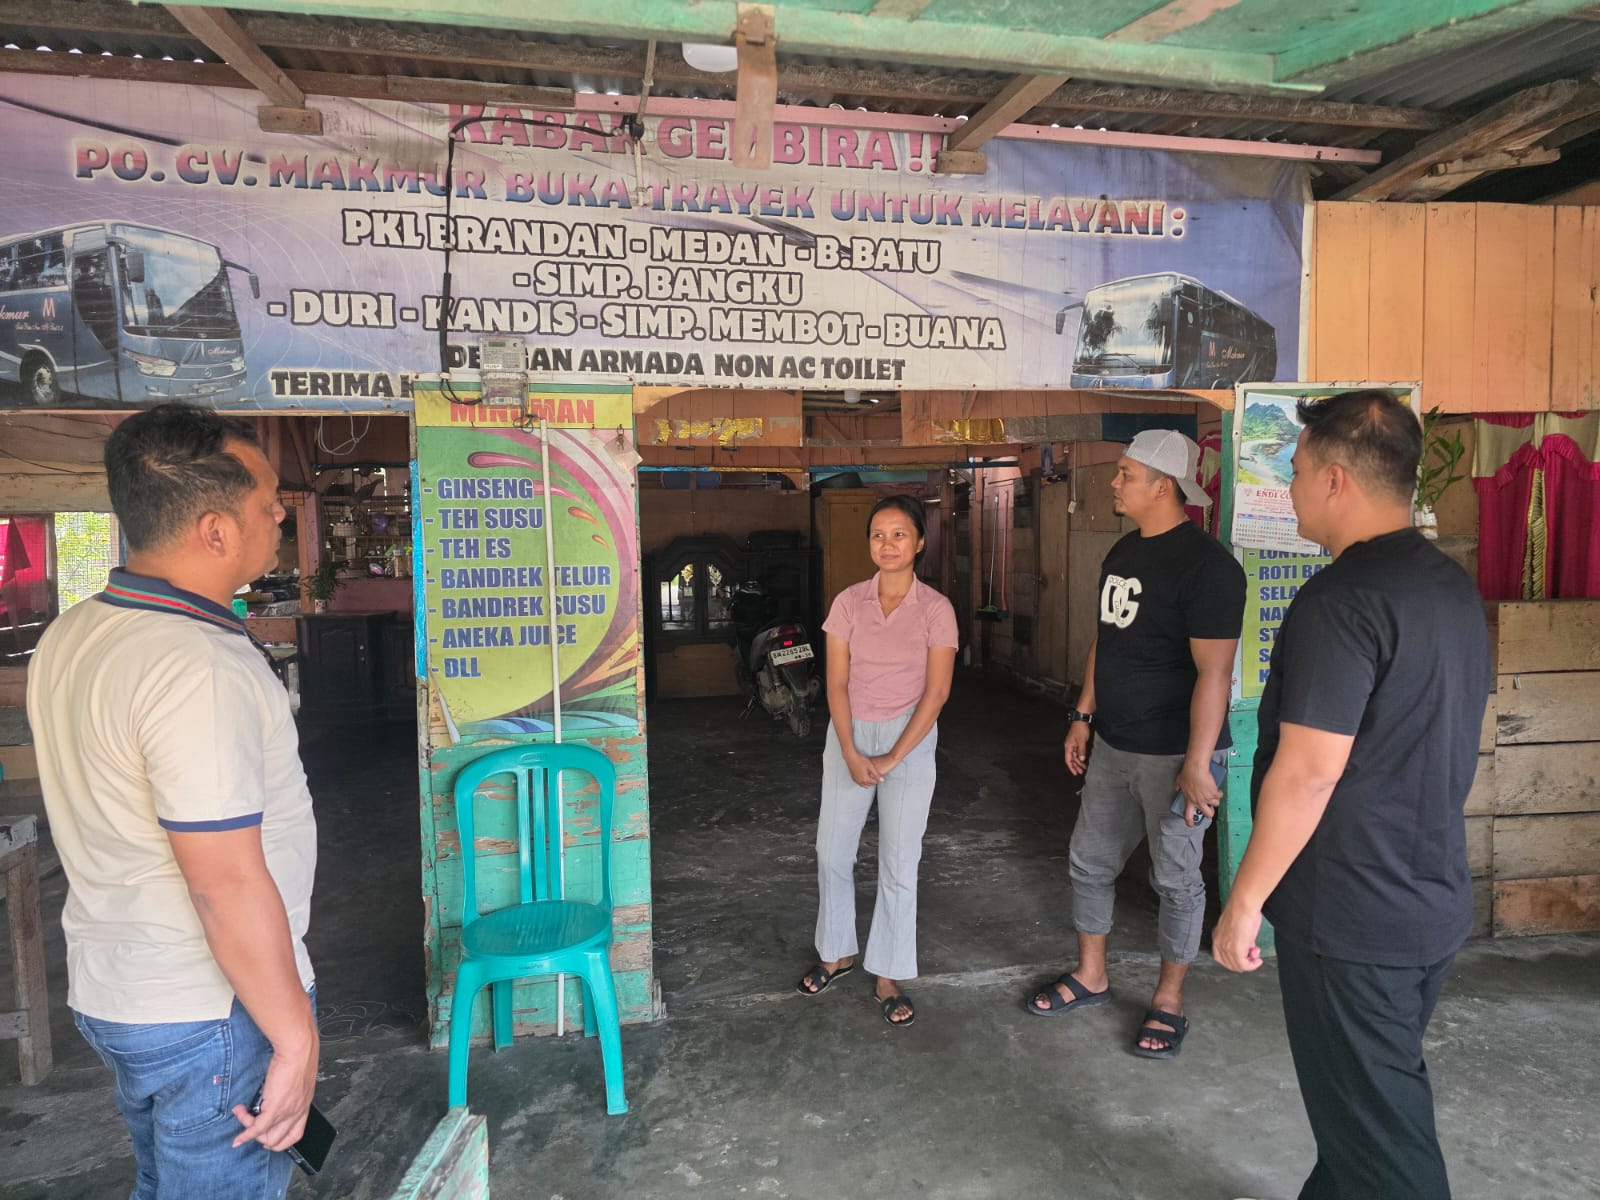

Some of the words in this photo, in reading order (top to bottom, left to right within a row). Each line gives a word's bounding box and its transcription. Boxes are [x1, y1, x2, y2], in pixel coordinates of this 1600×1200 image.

[657, 115, 898, 171] GEBIRA
[75, 143, 165, 182] PO.
[175, 146, 258, 187] CV.
[269, 153, 488, 200] MAKMUR
[505, 171, 632, 210] BUKA
[646, 182, 815, 220] TRAYEK
[831, 190, 964, 227] UNTUK
[342, 208, 425, 250] PKL
[650, 228, 787, 267] MEDAN
[814, 234, 941, 274] B.BATU
[646, 266, 802, 306] BANGKU
[290, 289, 396, 329] DURI
[423, 296, 577, 336] KANDIS
[708, 307, 864, 345] MEMBOT
[883, 312, 1007, 350] BUANA
[447, 345, 572, 371] DEAN
[579, 349, 704, 376] ARMADA
[714, 353, 773, 378] NON
[778, 355, 816, 379] AC
[821, 357, 906, 380] TOILET
[271, 371, 394, 398] TERIMA
[437, 478, 534, 499] GINSENG
[438, 509, 479, 529] TEH
[485, 508, 543, 529] SUSU
[439, 538, 480, 559] TEH
[485, 538, 512, 559] ES
[441, 566, 543, 589] BANDREK
[1259, 565, 1297, 581] ROTI
[442, 596, 544, 618] BANDREK
[443, 626, 514, 648] ANEKA
[518, 624, 577, 646] JUICE
[444, 657, 481, 678] DLL
